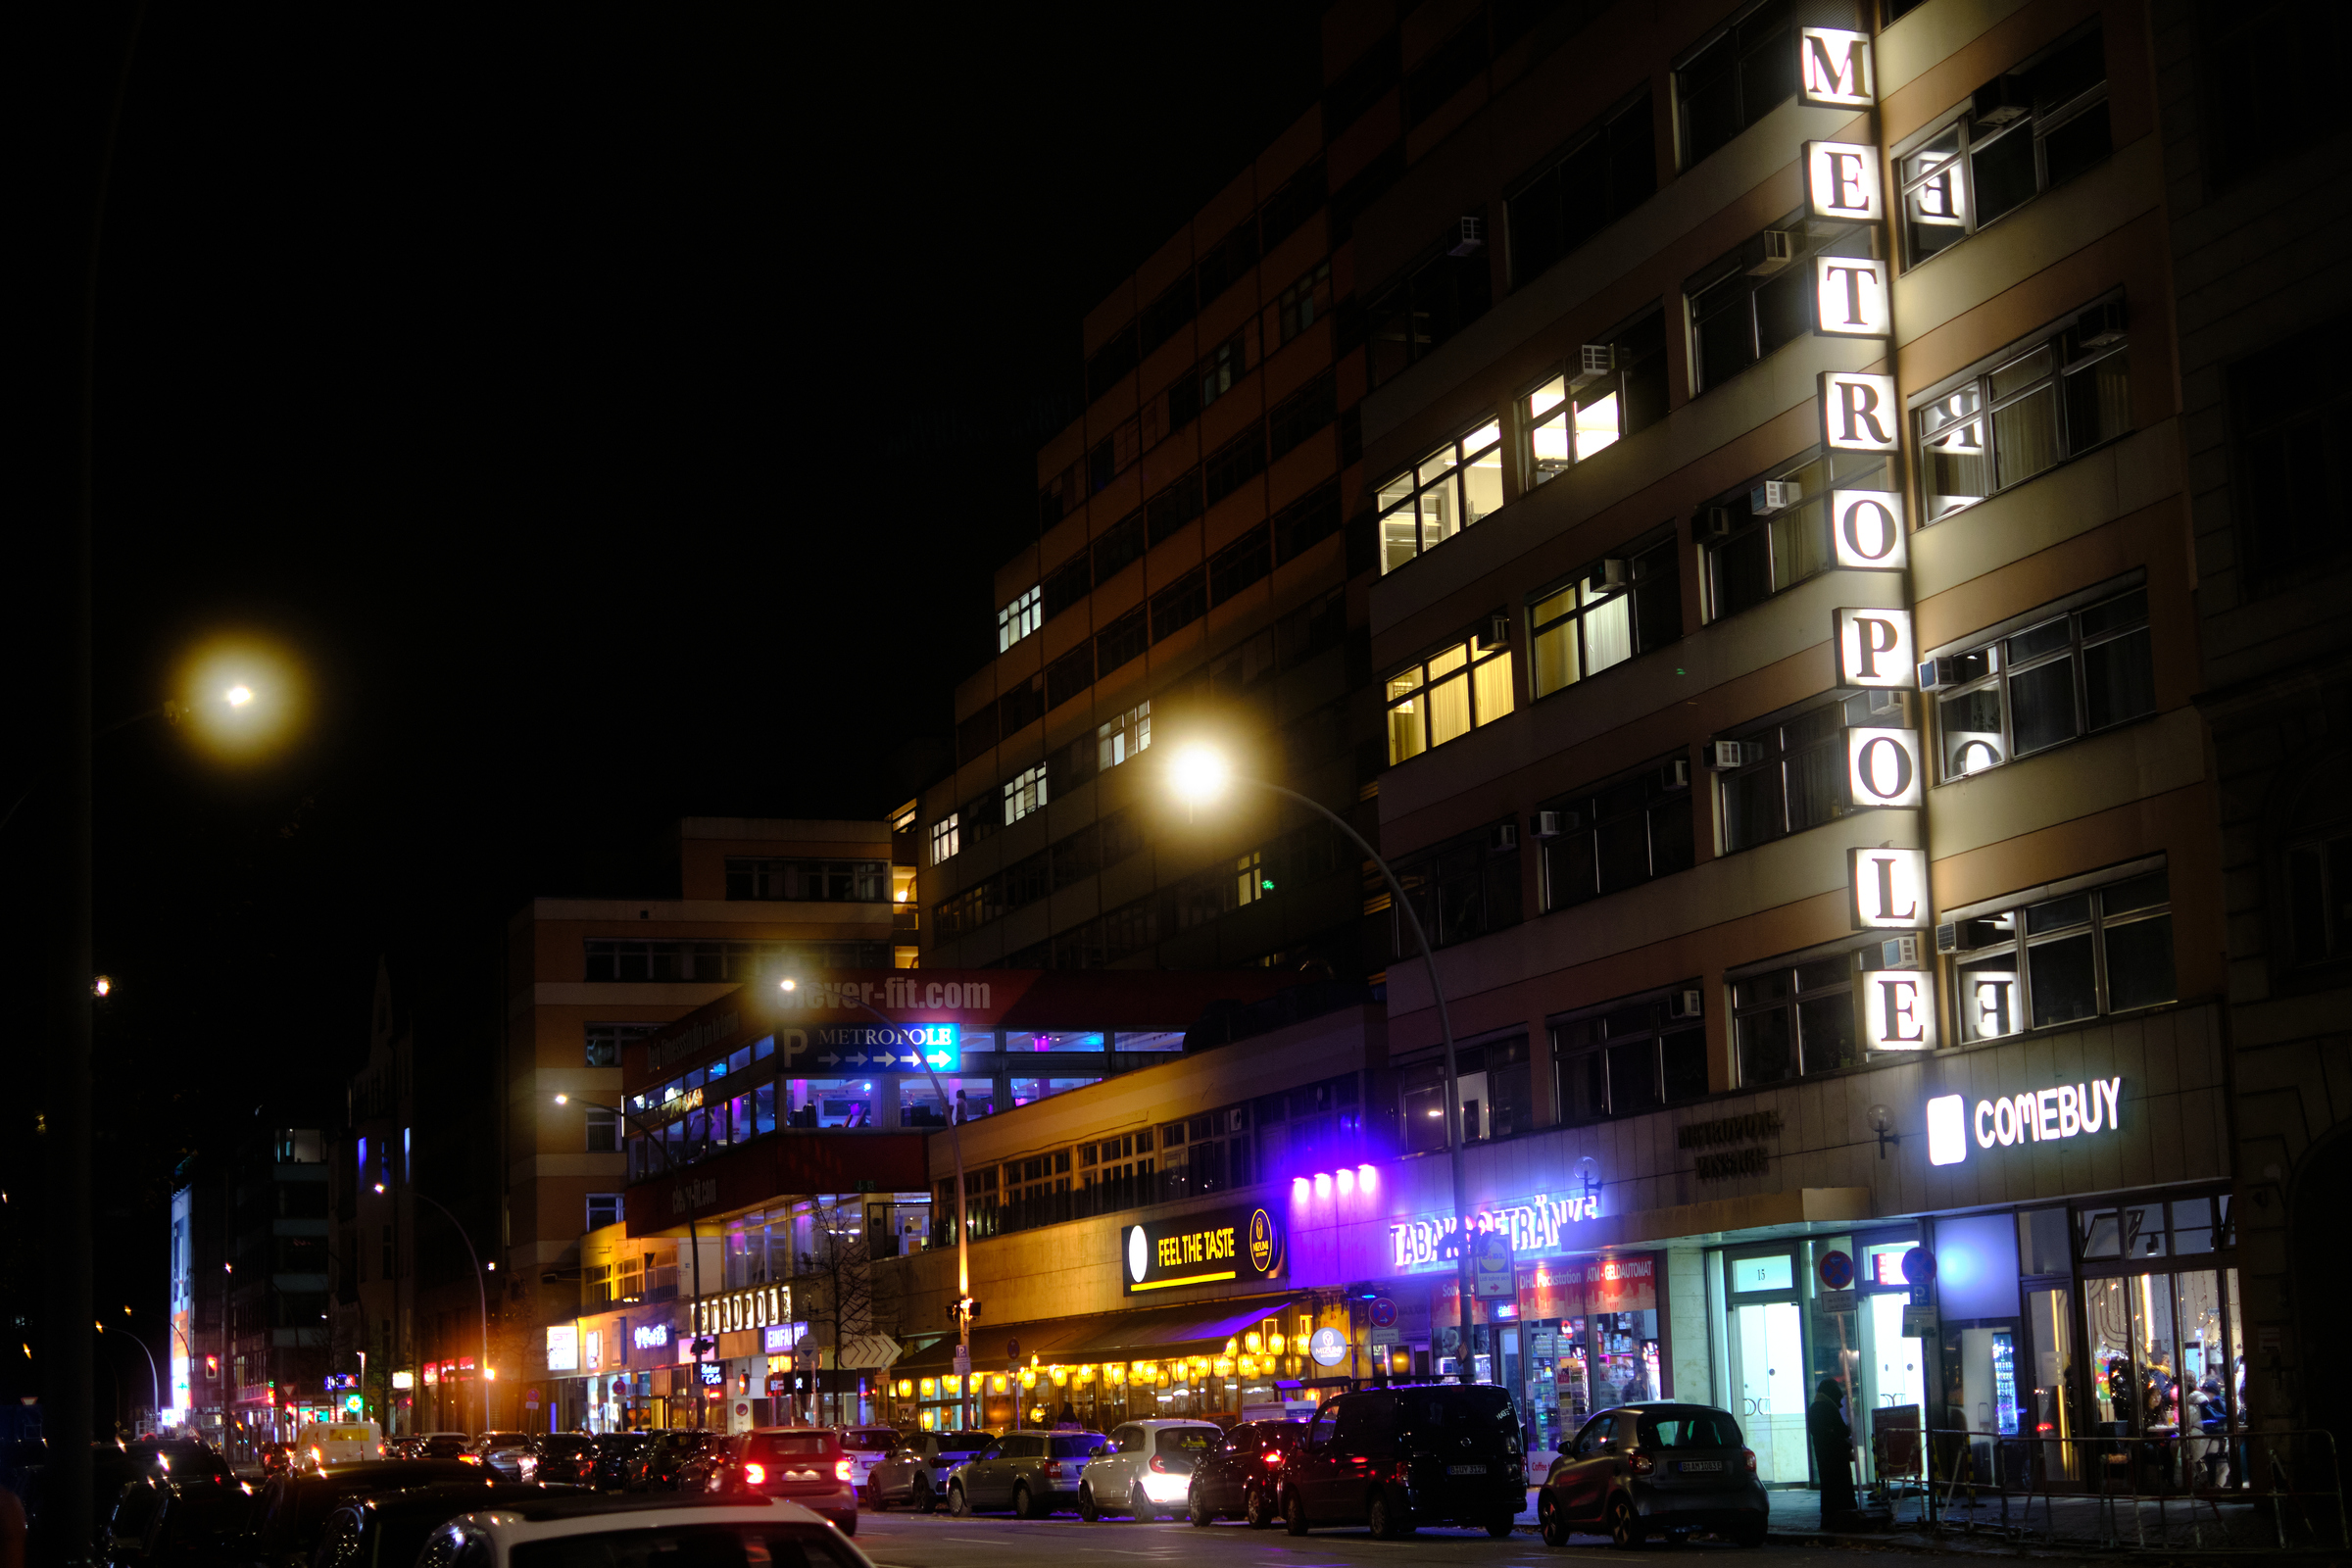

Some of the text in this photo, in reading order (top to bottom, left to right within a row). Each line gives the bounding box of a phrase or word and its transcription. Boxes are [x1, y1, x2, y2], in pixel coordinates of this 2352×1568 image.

[1805, 35, 1924, 1042] METROPOLE
[783, 1028, 953, 1068] P METROPOLE
[1974, 1076, 2122, 1149] COMEBUY
[1157, 1226, 1236, 1267] FEEL THE TASTE
[1519, 1269, 1582, 1290] DHL Packstation
[1587, 1266, 1600, 1282] ATM
[1604, 1260, 1652, 1281] GELDAUTOMAT
[1757, 1268, 1766, 1281] 15
[1315, 1346, 1344, 1355] MIZUMI
[1532, 1461, 1547, 1472] Coffee
